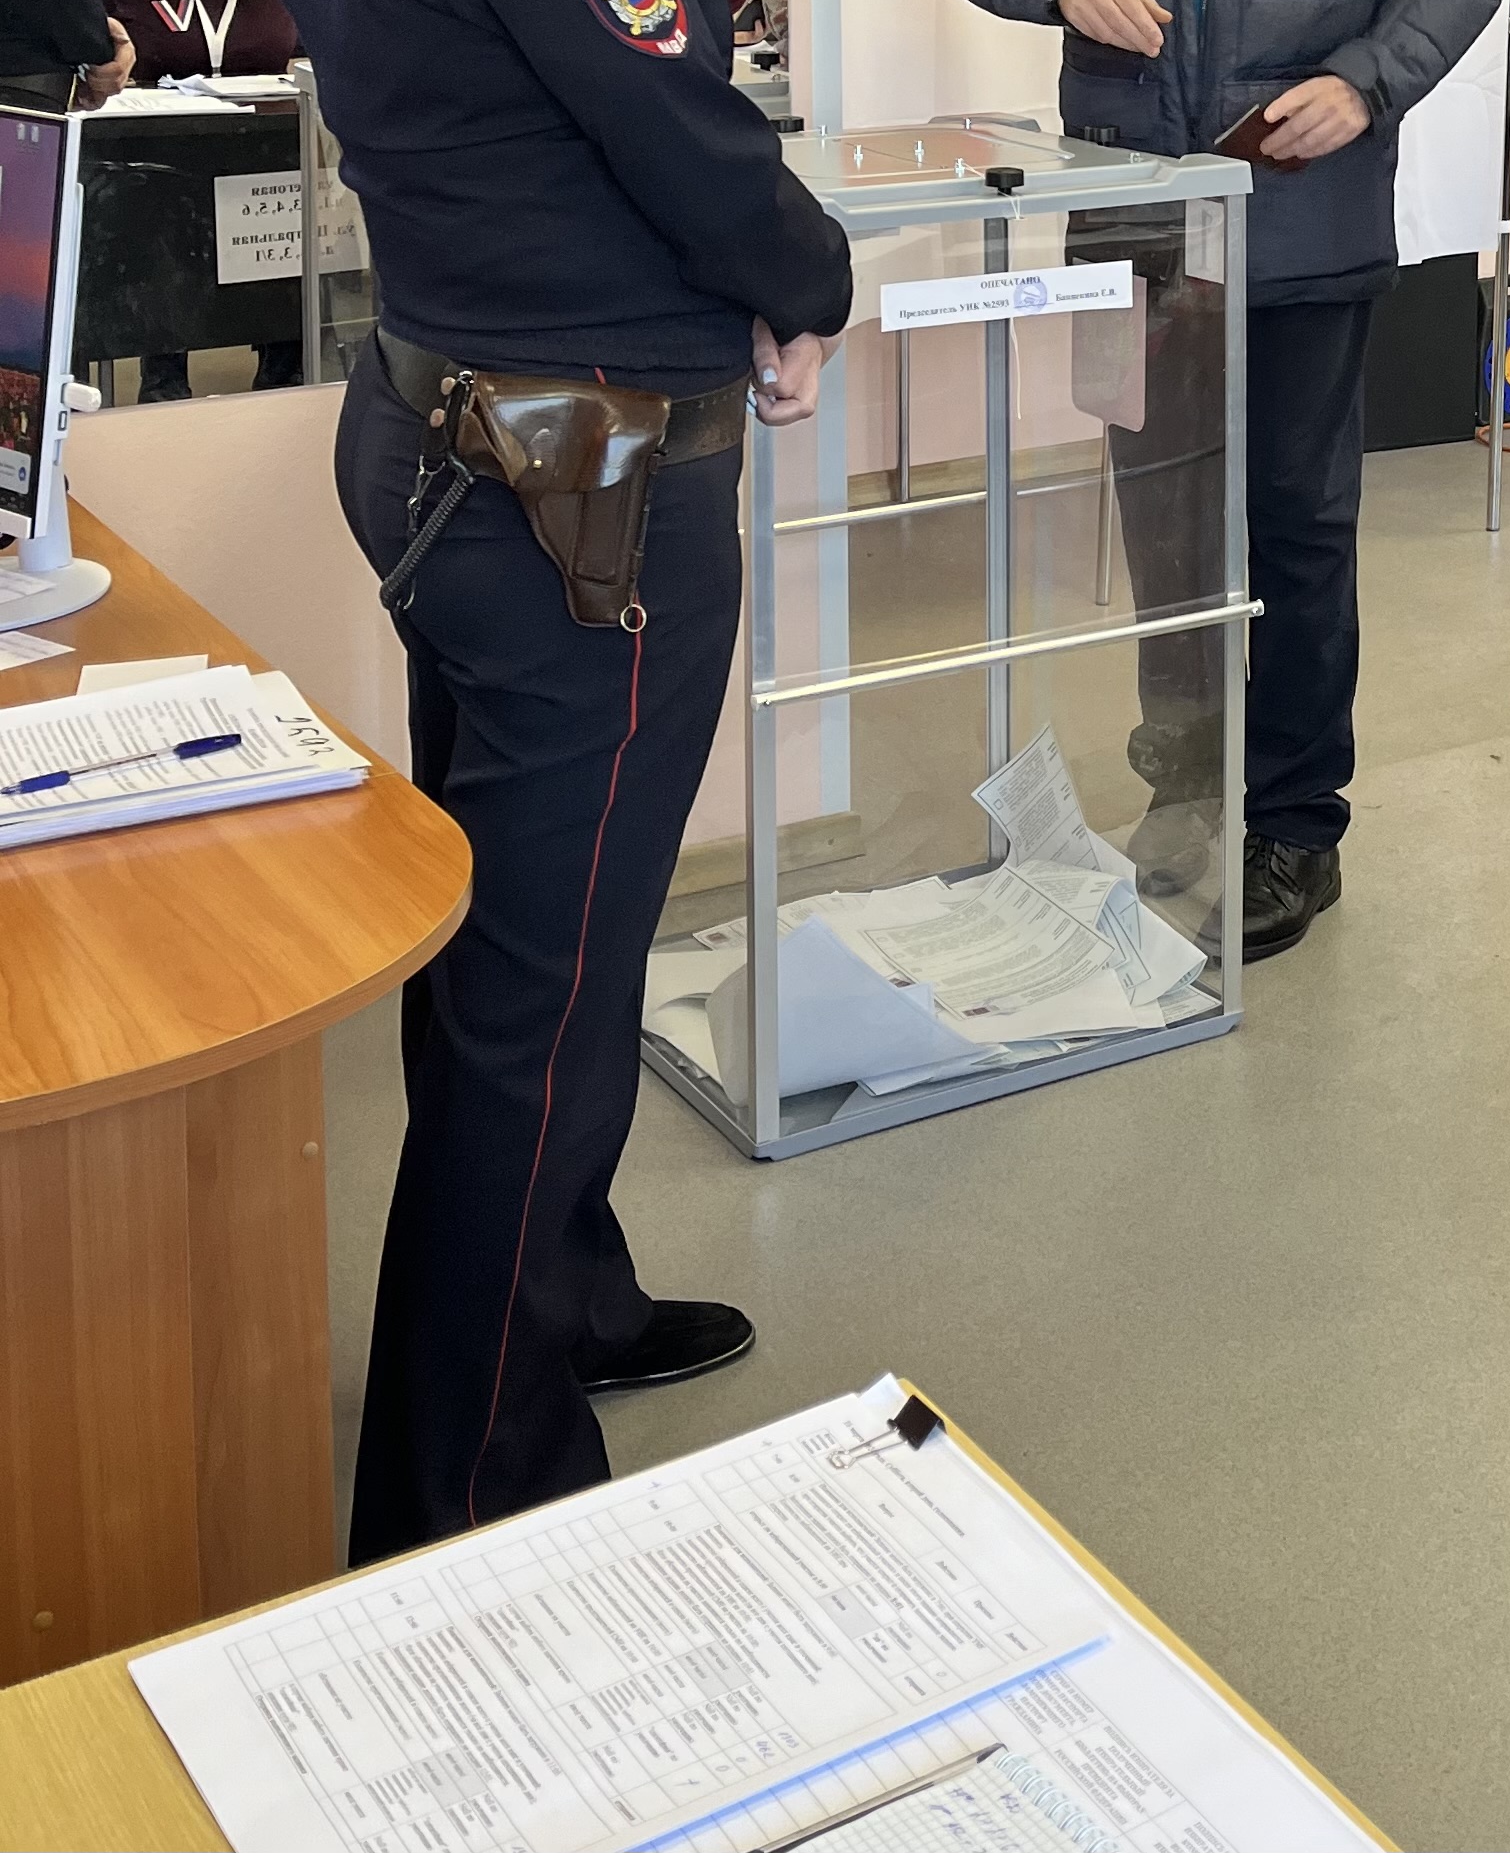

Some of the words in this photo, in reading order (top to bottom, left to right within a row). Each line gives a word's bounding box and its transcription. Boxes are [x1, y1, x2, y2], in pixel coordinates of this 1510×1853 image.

[980, 276, 1041, 290] ОПЕЧАТАНО
[899, 307, 958, 319] Председатель
[959, 303, 980, 316] УИК
